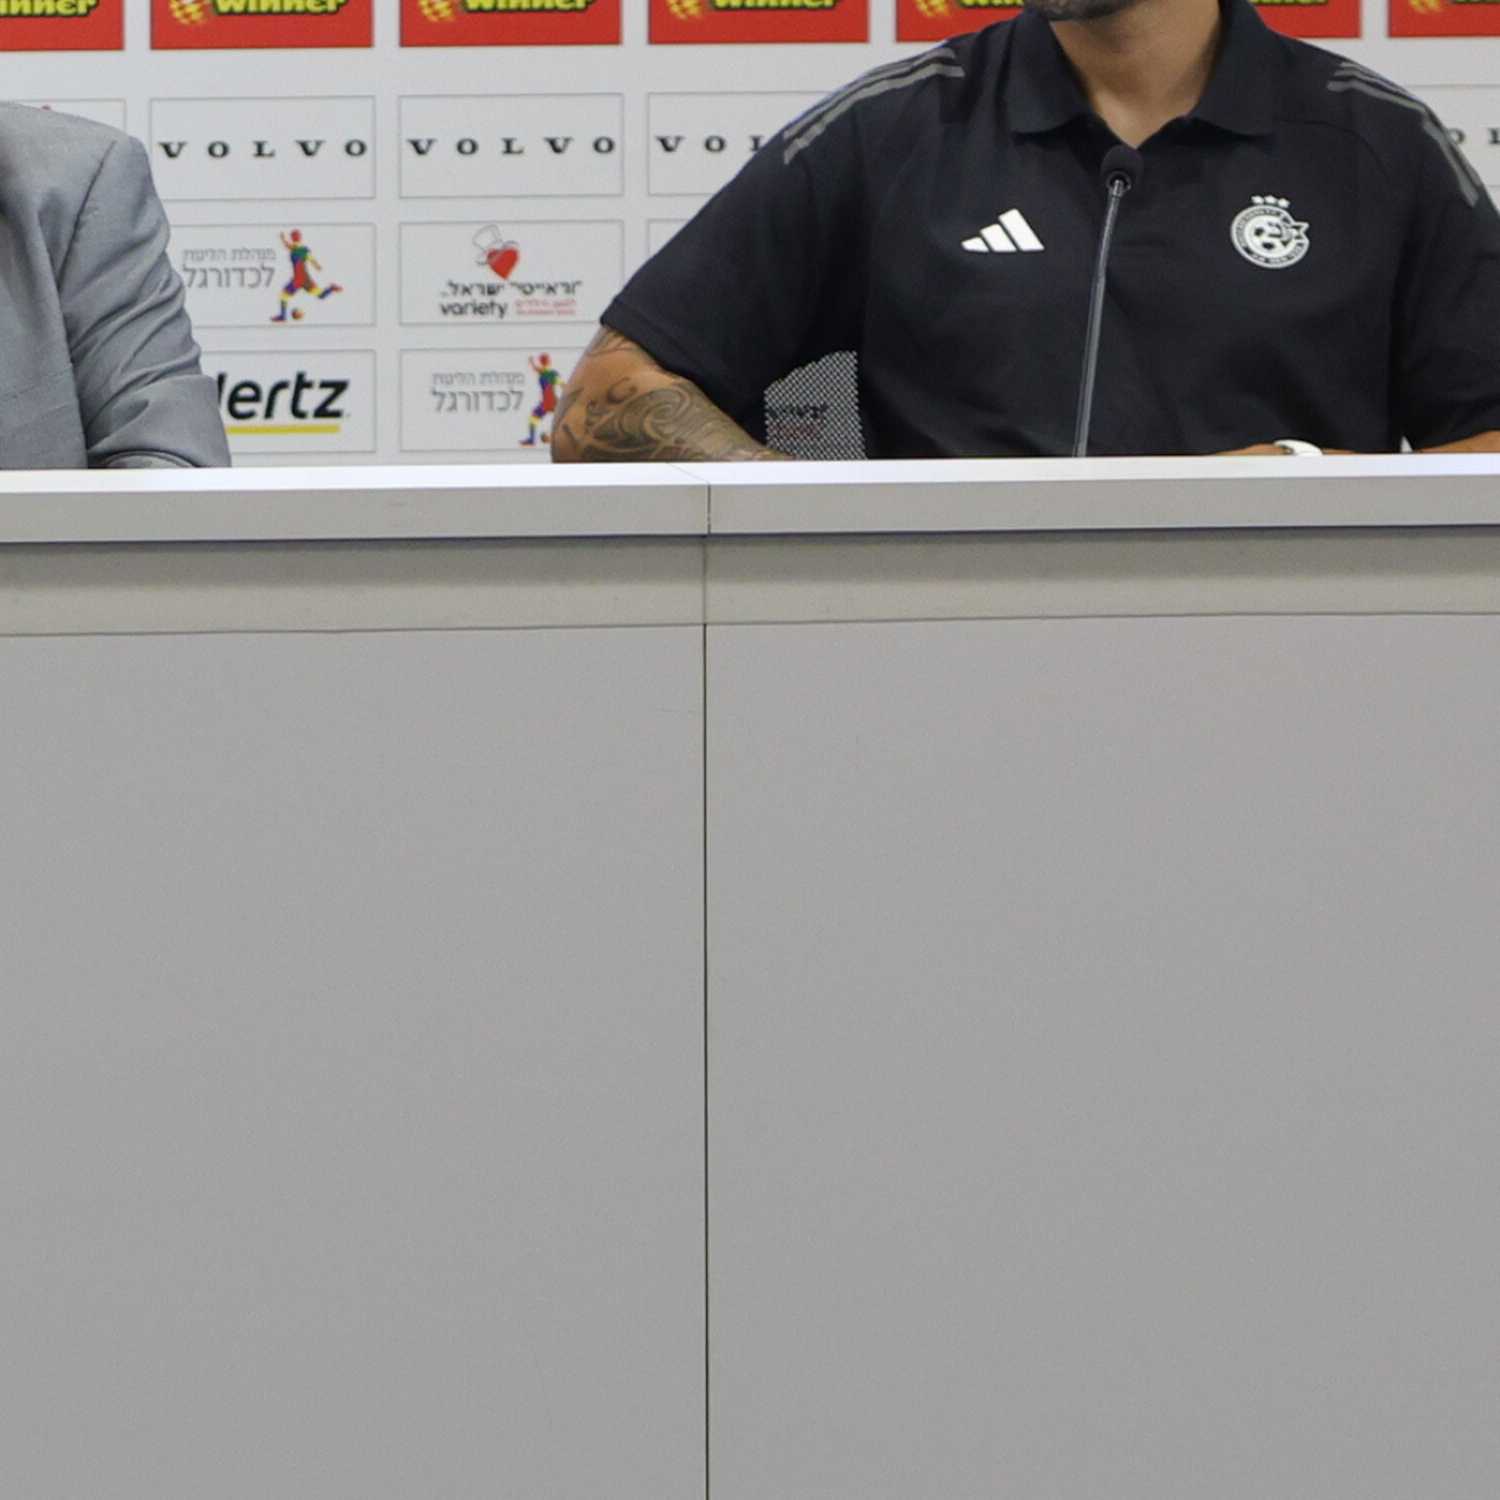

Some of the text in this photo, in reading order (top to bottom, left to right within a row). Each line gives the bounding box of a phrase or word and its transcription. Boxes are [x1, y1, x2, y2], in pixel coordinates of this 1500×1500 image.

[158, 139, 368, 160] VOLVO
[407, 136, 616, 157] VOLVO
[182, 262, 276, 289] לכדורגל
[430, 385, 525, 413] לכדורגל
